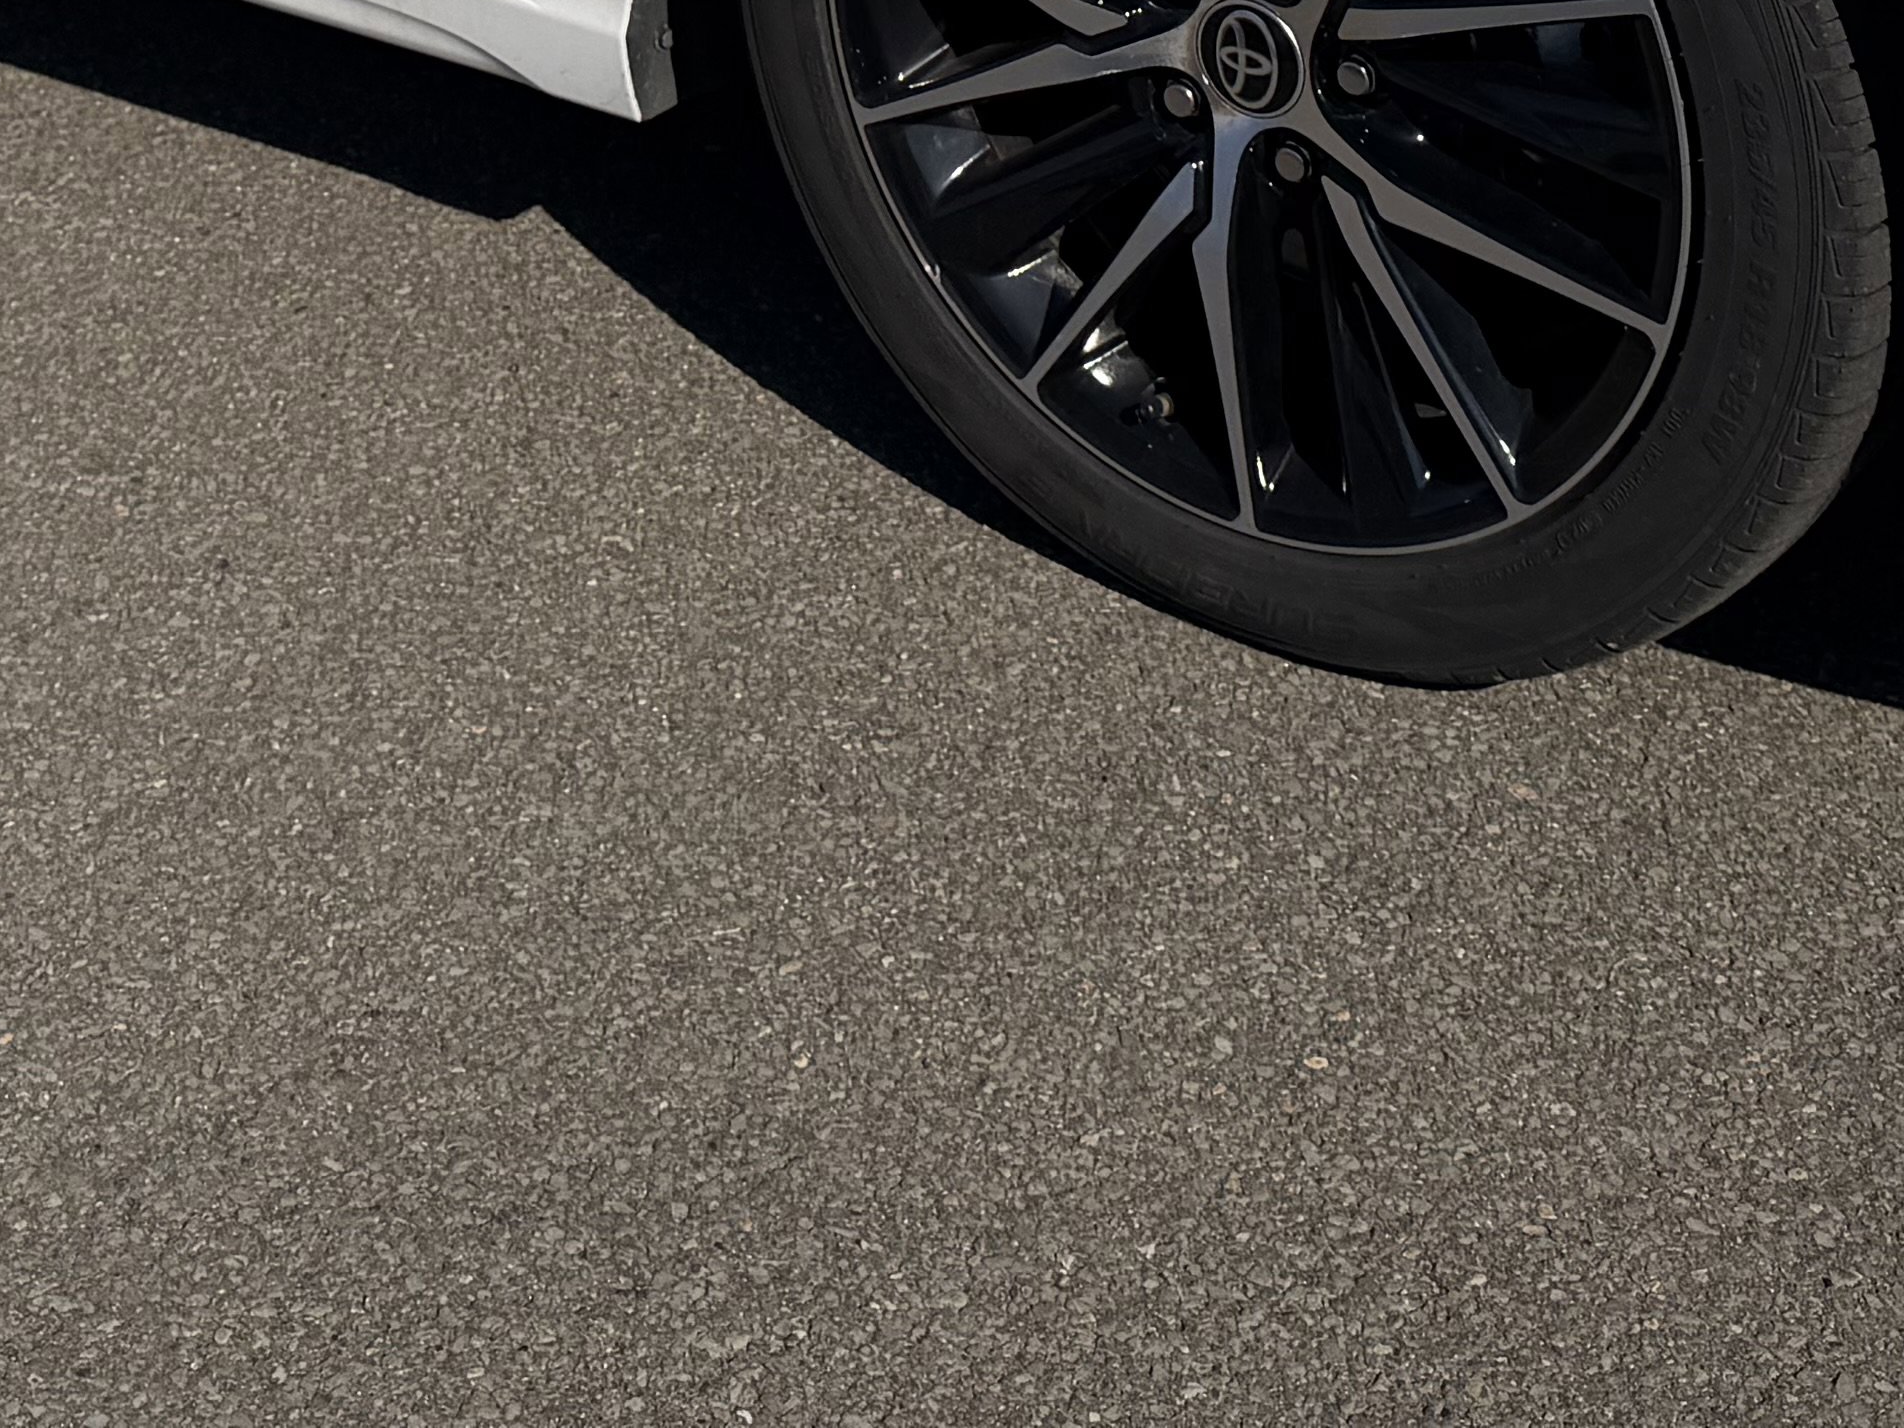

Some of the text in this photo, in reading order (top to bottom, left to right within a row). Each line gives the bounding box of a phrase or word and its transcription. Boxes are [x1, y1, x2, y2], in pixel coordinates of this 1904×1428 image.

[1695, 77, 1781, 467] 235/45 R18 98W
